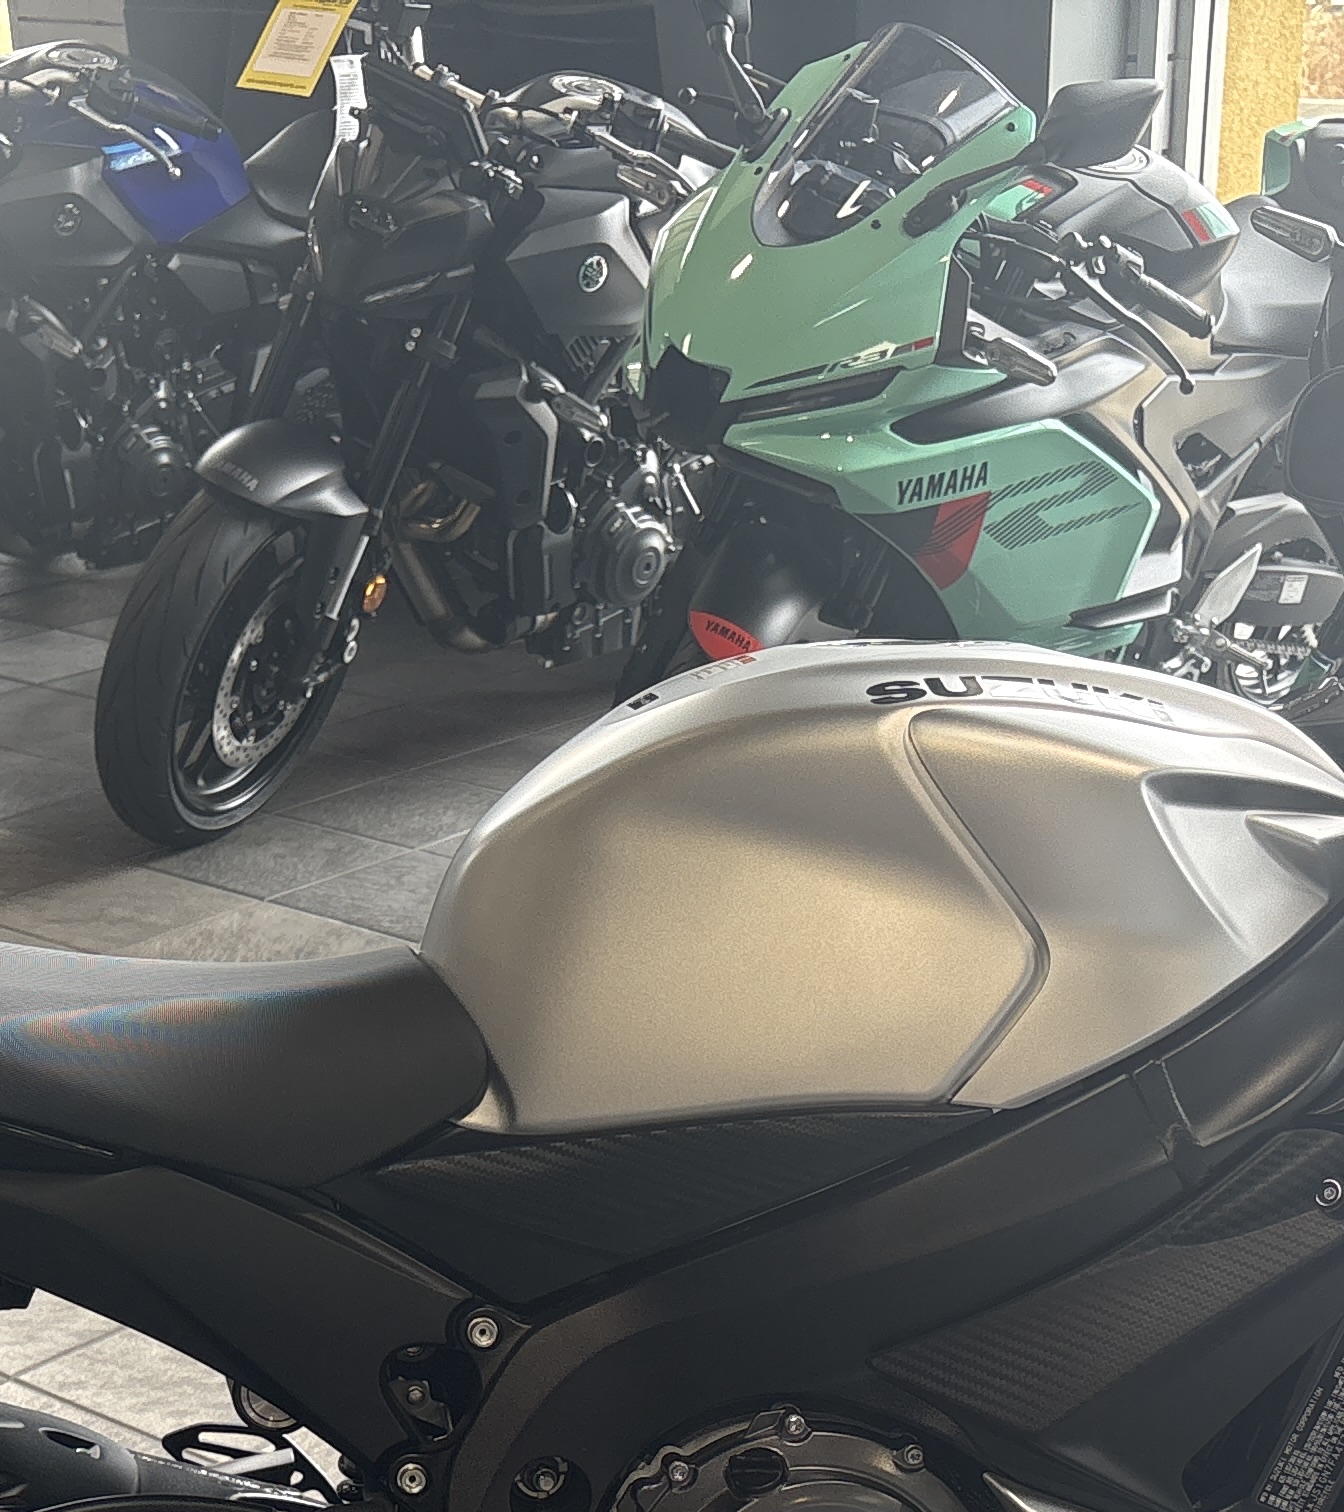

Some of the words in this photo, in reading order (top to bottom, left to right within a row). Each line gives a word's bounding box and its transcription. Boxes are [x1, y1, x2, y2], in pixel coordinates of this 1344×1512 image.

[897, 461, 989, 505] YAMAHA
[706, 620, 751, 652] YAMAHA
[1270, 1457, 1286, 1481] SUZUKI
[1284, 1434, 1298, 1455] MOTOR
[1296, 1386, 1324, 1432] CORPORATION
